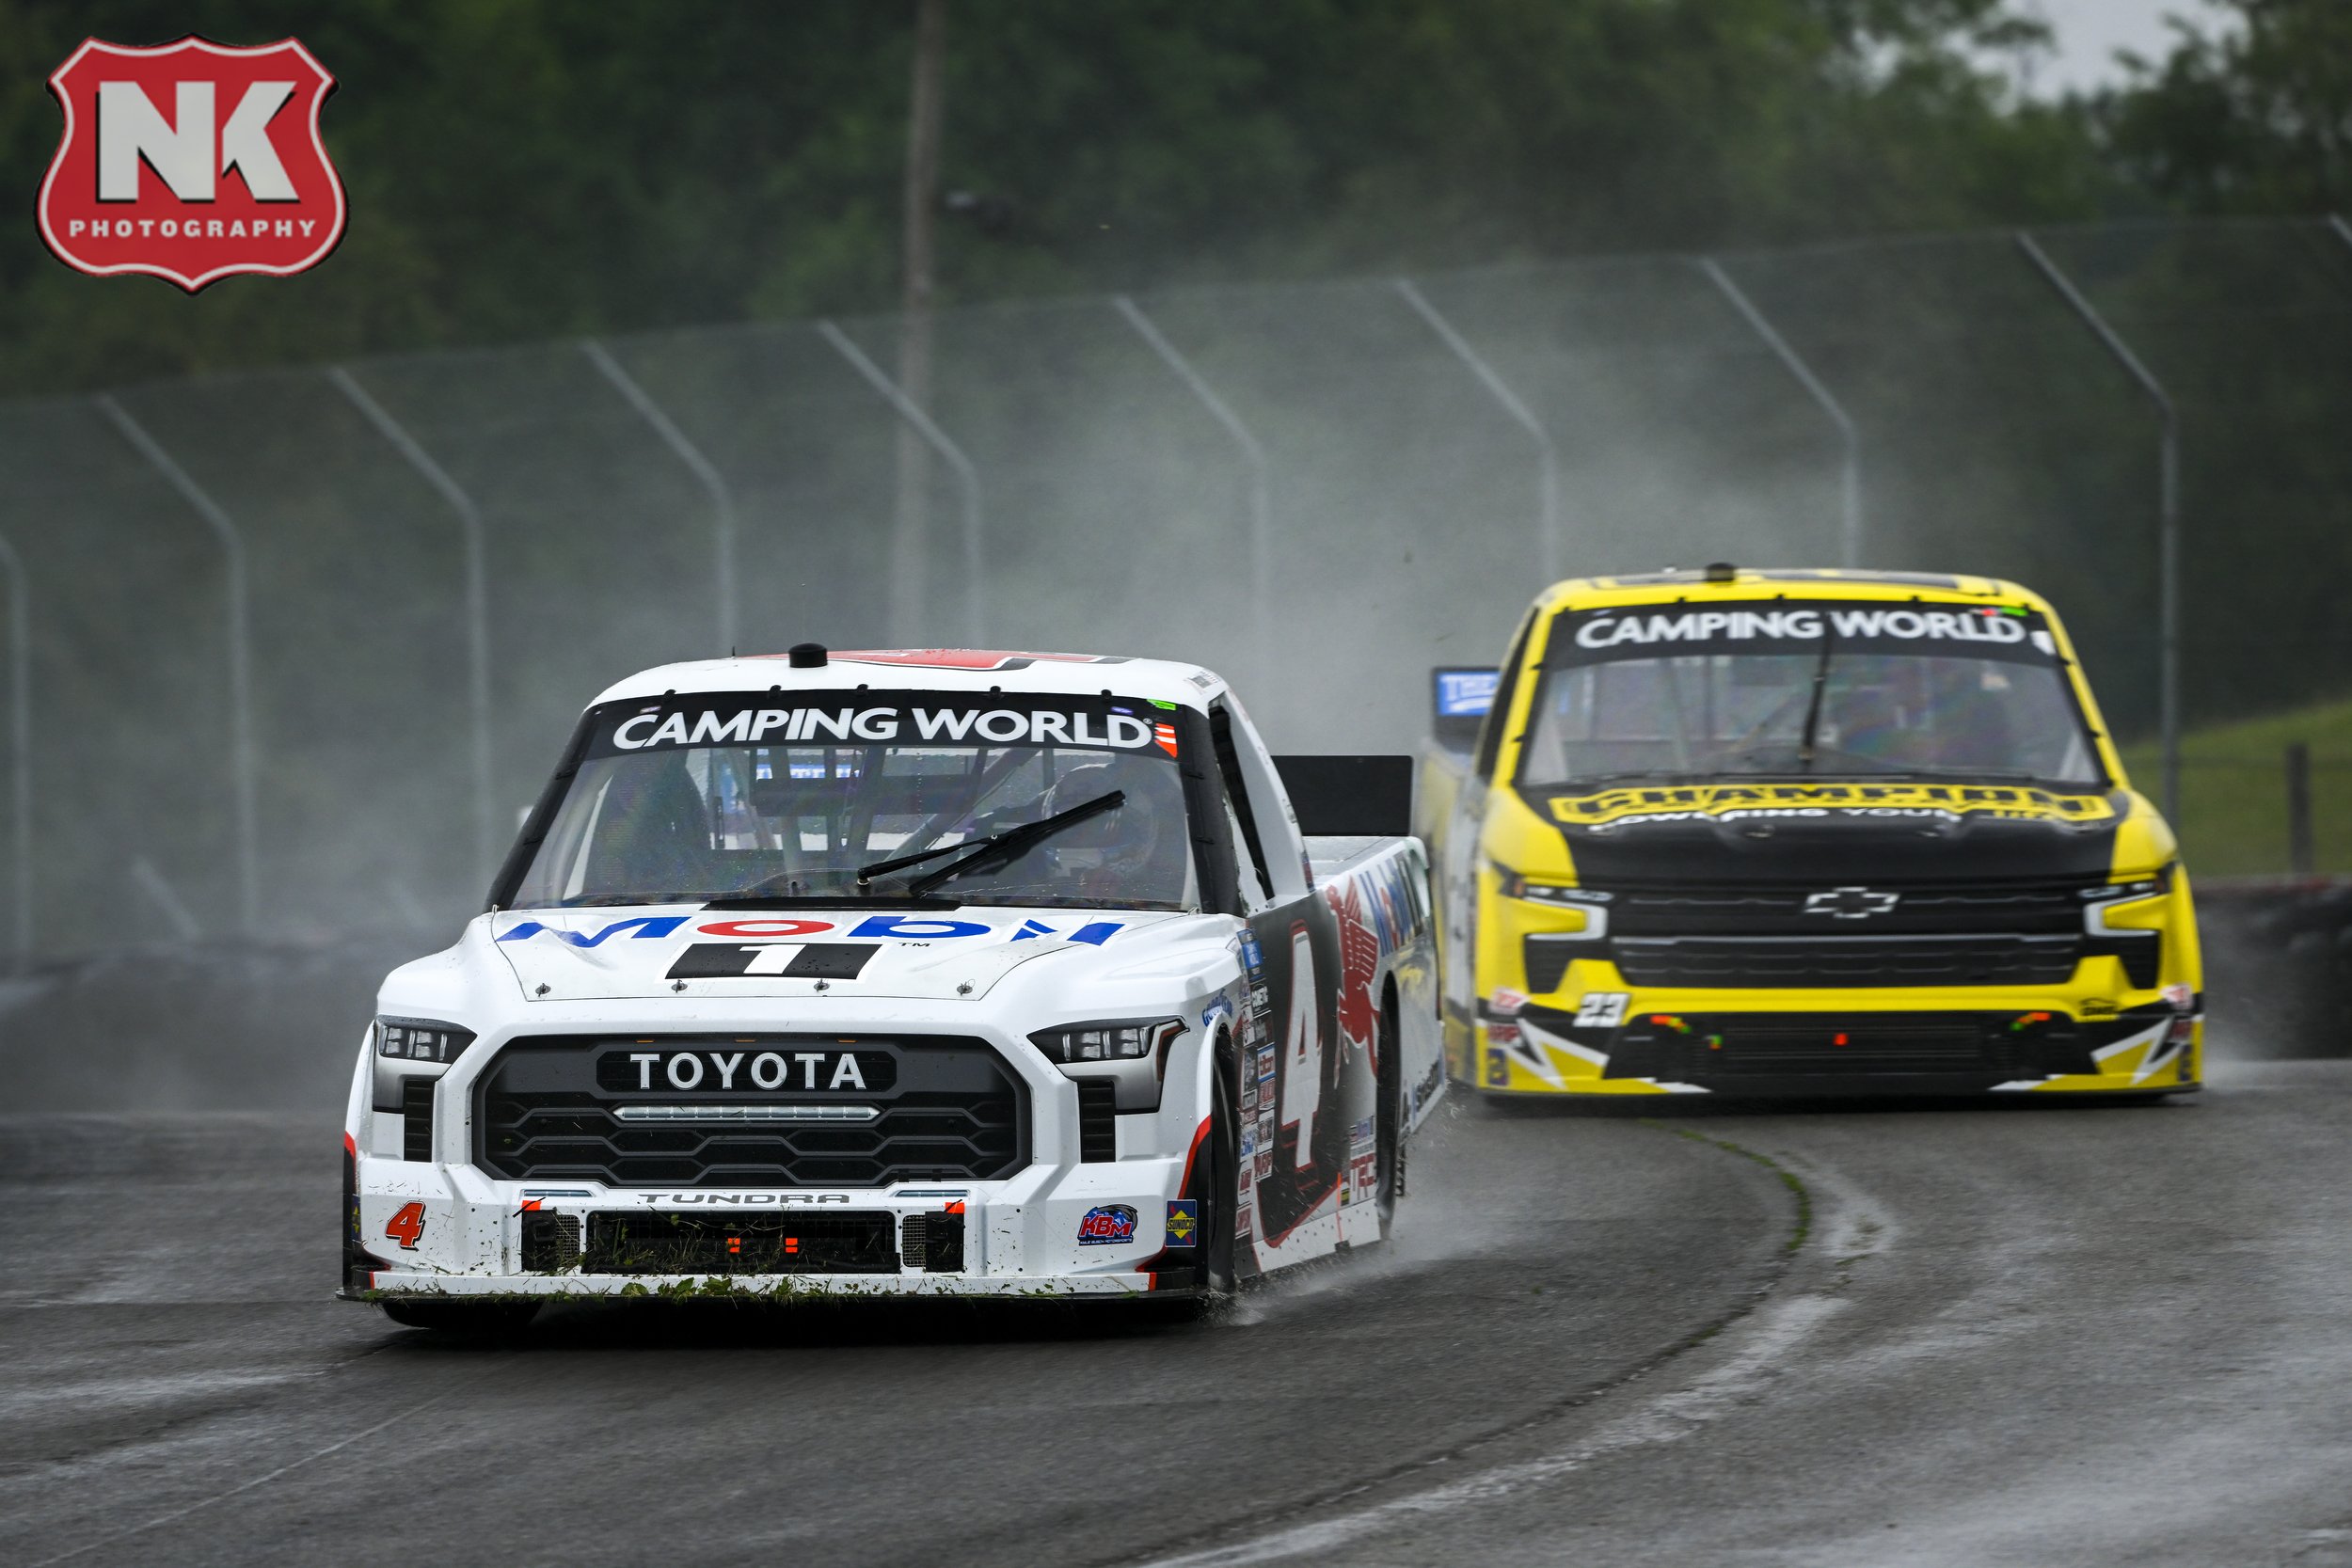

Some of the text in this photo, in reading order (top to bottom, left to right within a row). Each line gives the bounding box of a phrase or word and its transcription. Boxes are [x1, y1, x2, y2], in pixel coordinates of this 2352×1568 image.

[1576, 610, 2026, 648] CAMPING WORLD
[613, 706, 896, 750] CAMPING
[739, 943, 807, 974] 1
[1572, 992, 1631, 1027] 23
[1280, 924, 1324, 1171] 4
[629, 1052, 867, 1090] TOYOTA
[637, 1194, 850, 1204] TUNDRA
[385, 1200, 427, 1252] 4
[1078, 1214, 1133, 1238] KBM
[1168, 1217, 1195, 1231] SUNOCO
